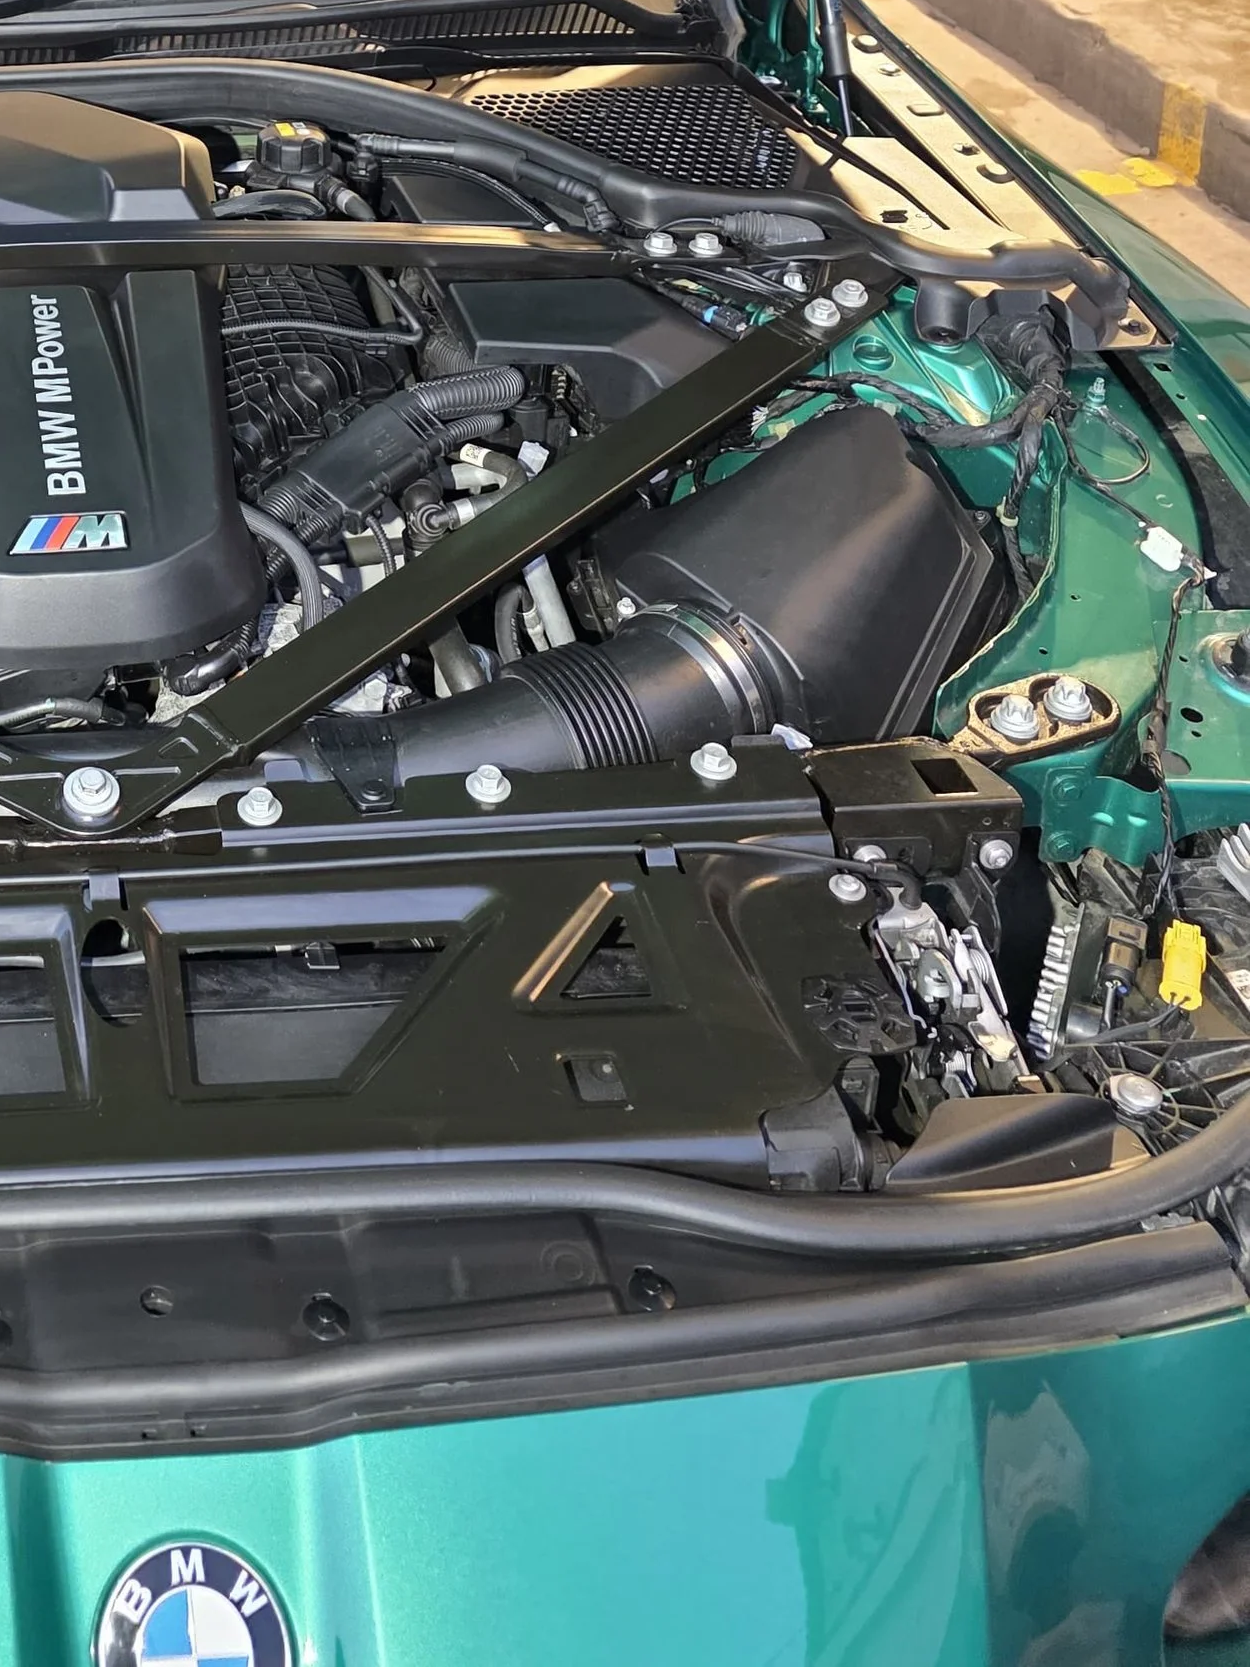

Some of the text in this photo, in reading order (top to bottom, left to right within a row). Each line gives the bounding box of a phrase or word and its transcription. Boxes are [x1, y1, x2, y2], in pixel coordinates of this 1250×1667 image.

[30, 294, 86, 495] BMW MPower
[110, 1547, 269, 1625] BMW
